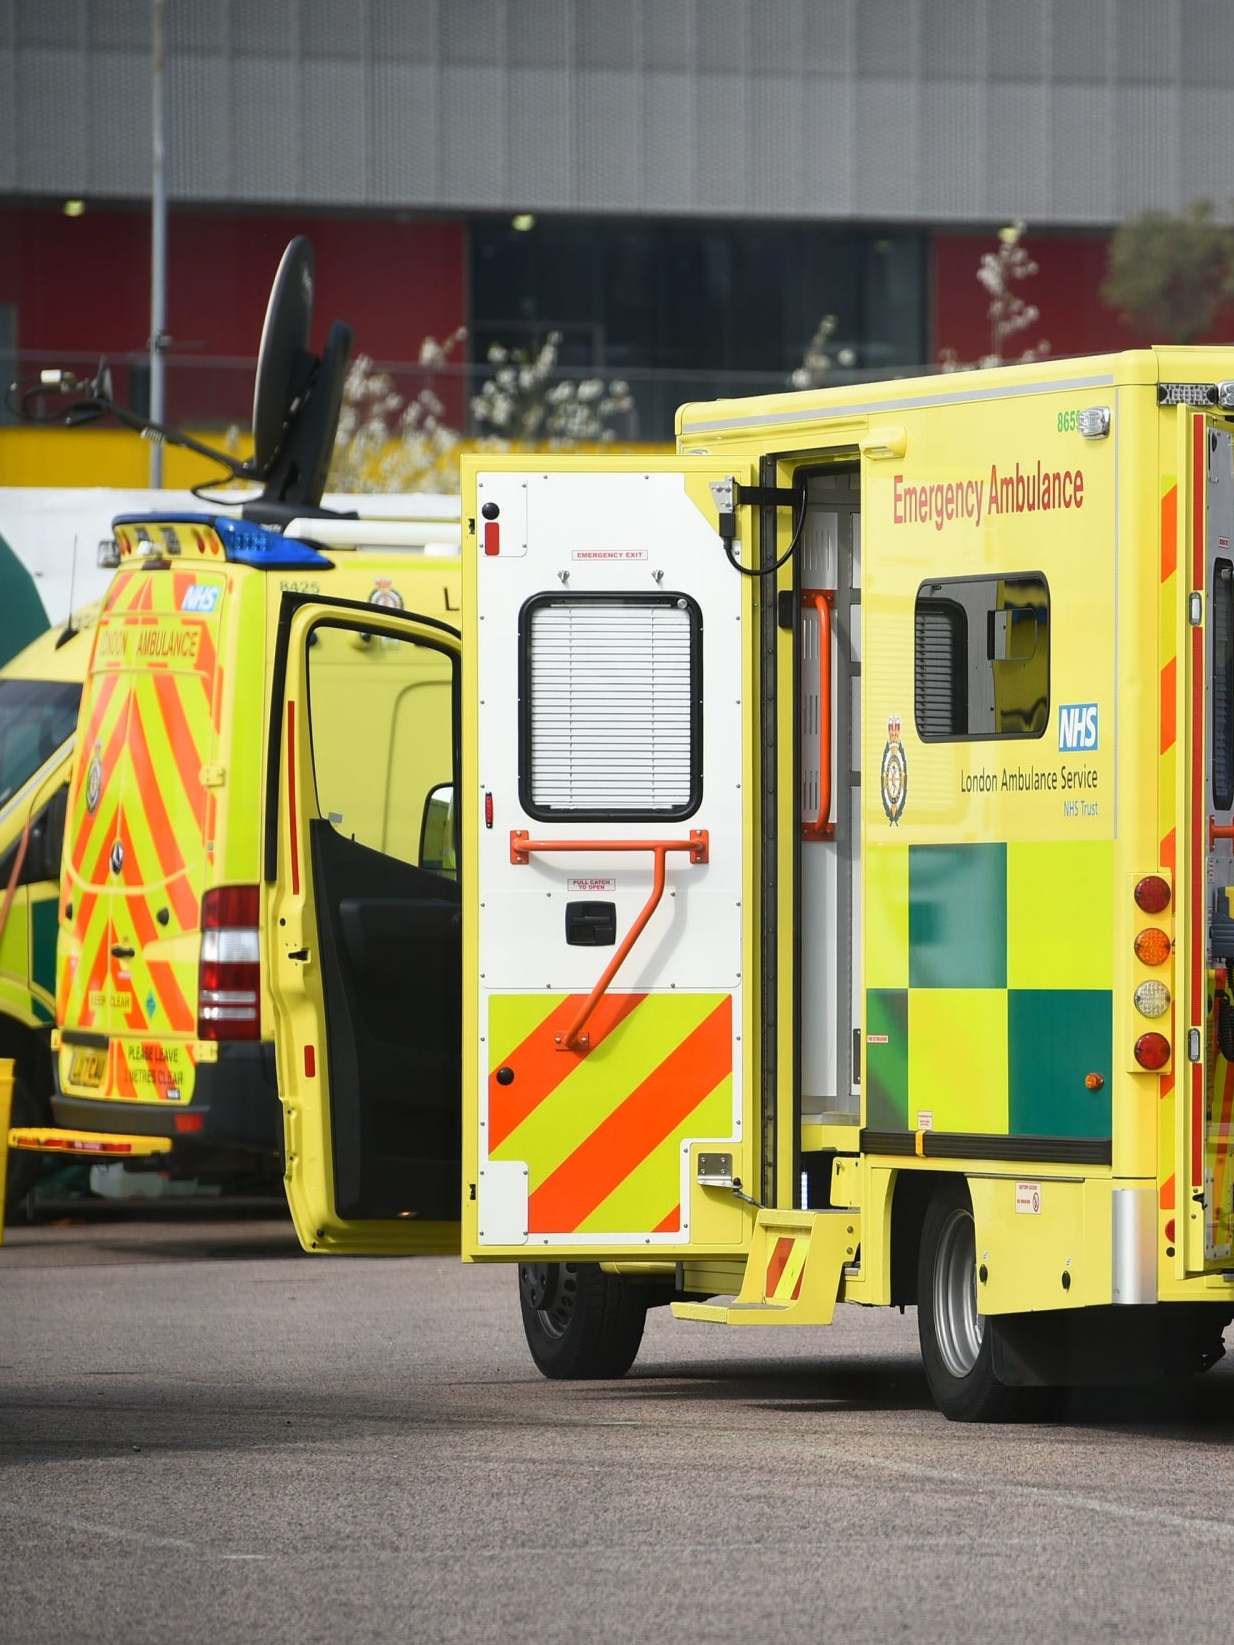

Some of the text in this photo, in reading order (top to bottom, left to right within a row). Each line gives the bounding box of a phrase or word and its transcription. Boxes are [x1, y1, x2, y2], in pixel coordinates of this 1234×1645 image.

[893, 460, 1084, 531] Emergency Ambulance
[576, 551, 643, 559] EMERGENCY EXIT
[182, 585, 218, 612] NHS
[136, 630, 198, 657] AMBULANCE
[1059, 707, 1097, 749] NHS
[961, 763, 1098, 793] London Ambulance Service
[1064, 799, 1098, 817] NHS Trust
[155, 1046, 179, 1063] LEAVE
